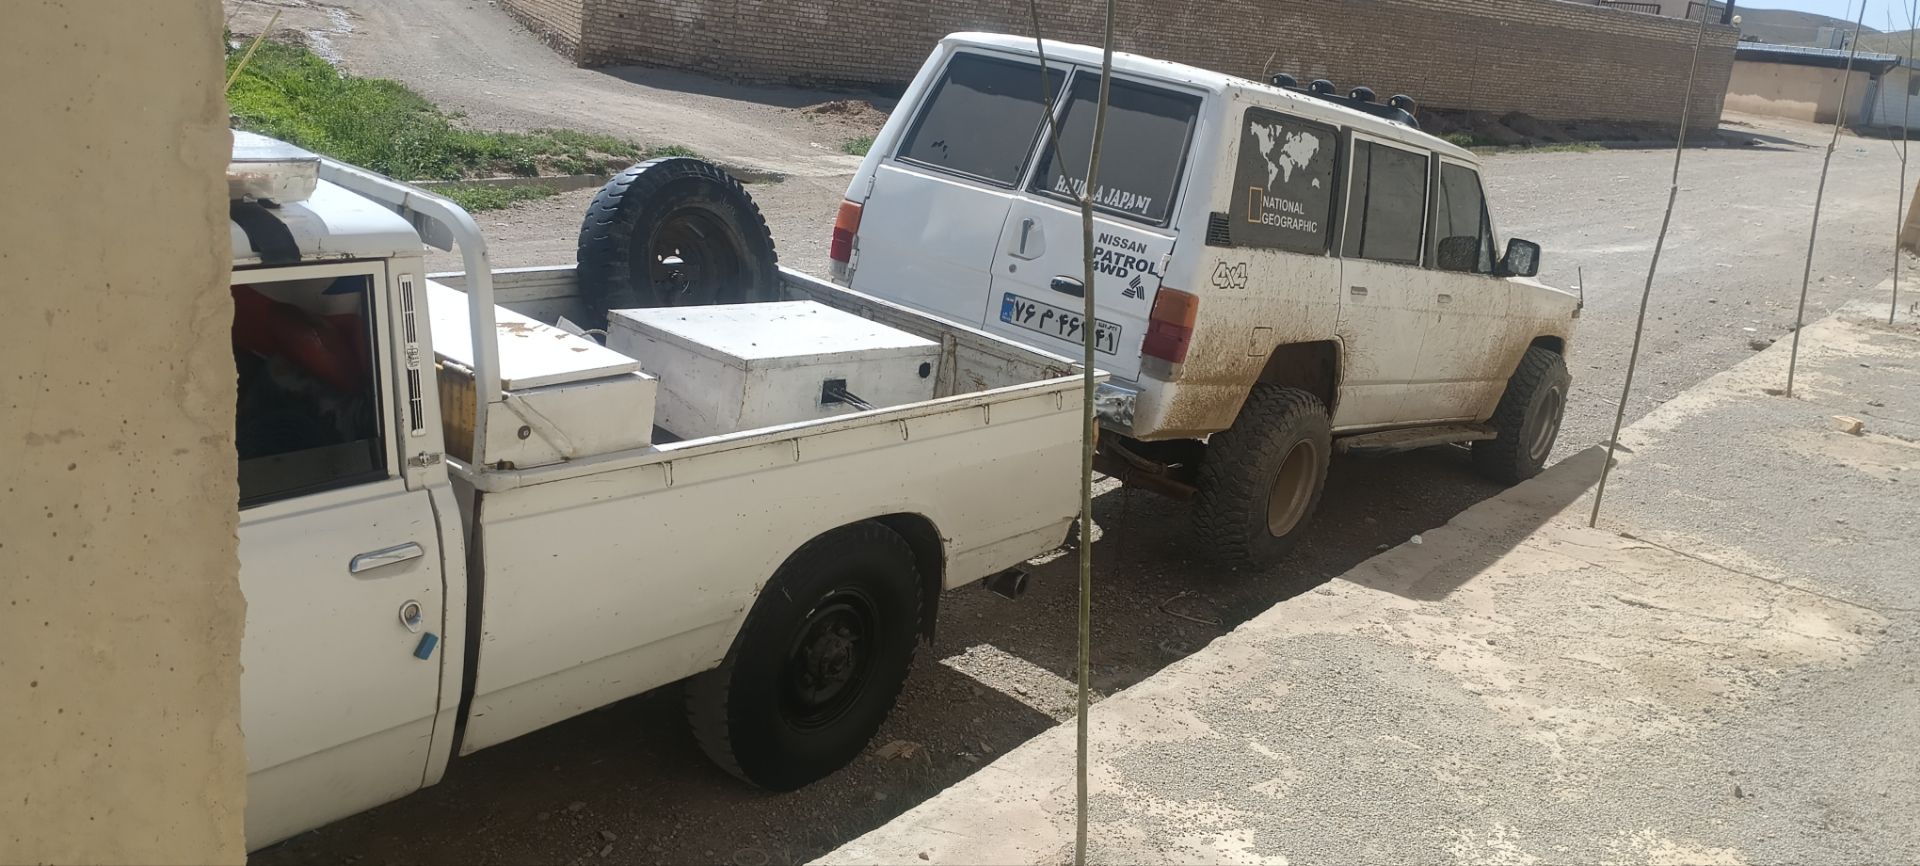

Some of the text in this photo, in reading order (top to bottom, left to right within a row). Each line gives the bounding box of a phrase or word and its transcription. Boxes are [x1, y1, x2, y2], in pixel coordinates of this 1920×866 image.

[1104, 188, 1151, 214] JAPANI
[1262, 195, 1305, 215] NATIONAL
[1261, 212, 1318, 233] GEOGRAPHIC
[1098, 232, 1147, 254] NISSAN
[1093, 246, 1159, 276] PATROL
